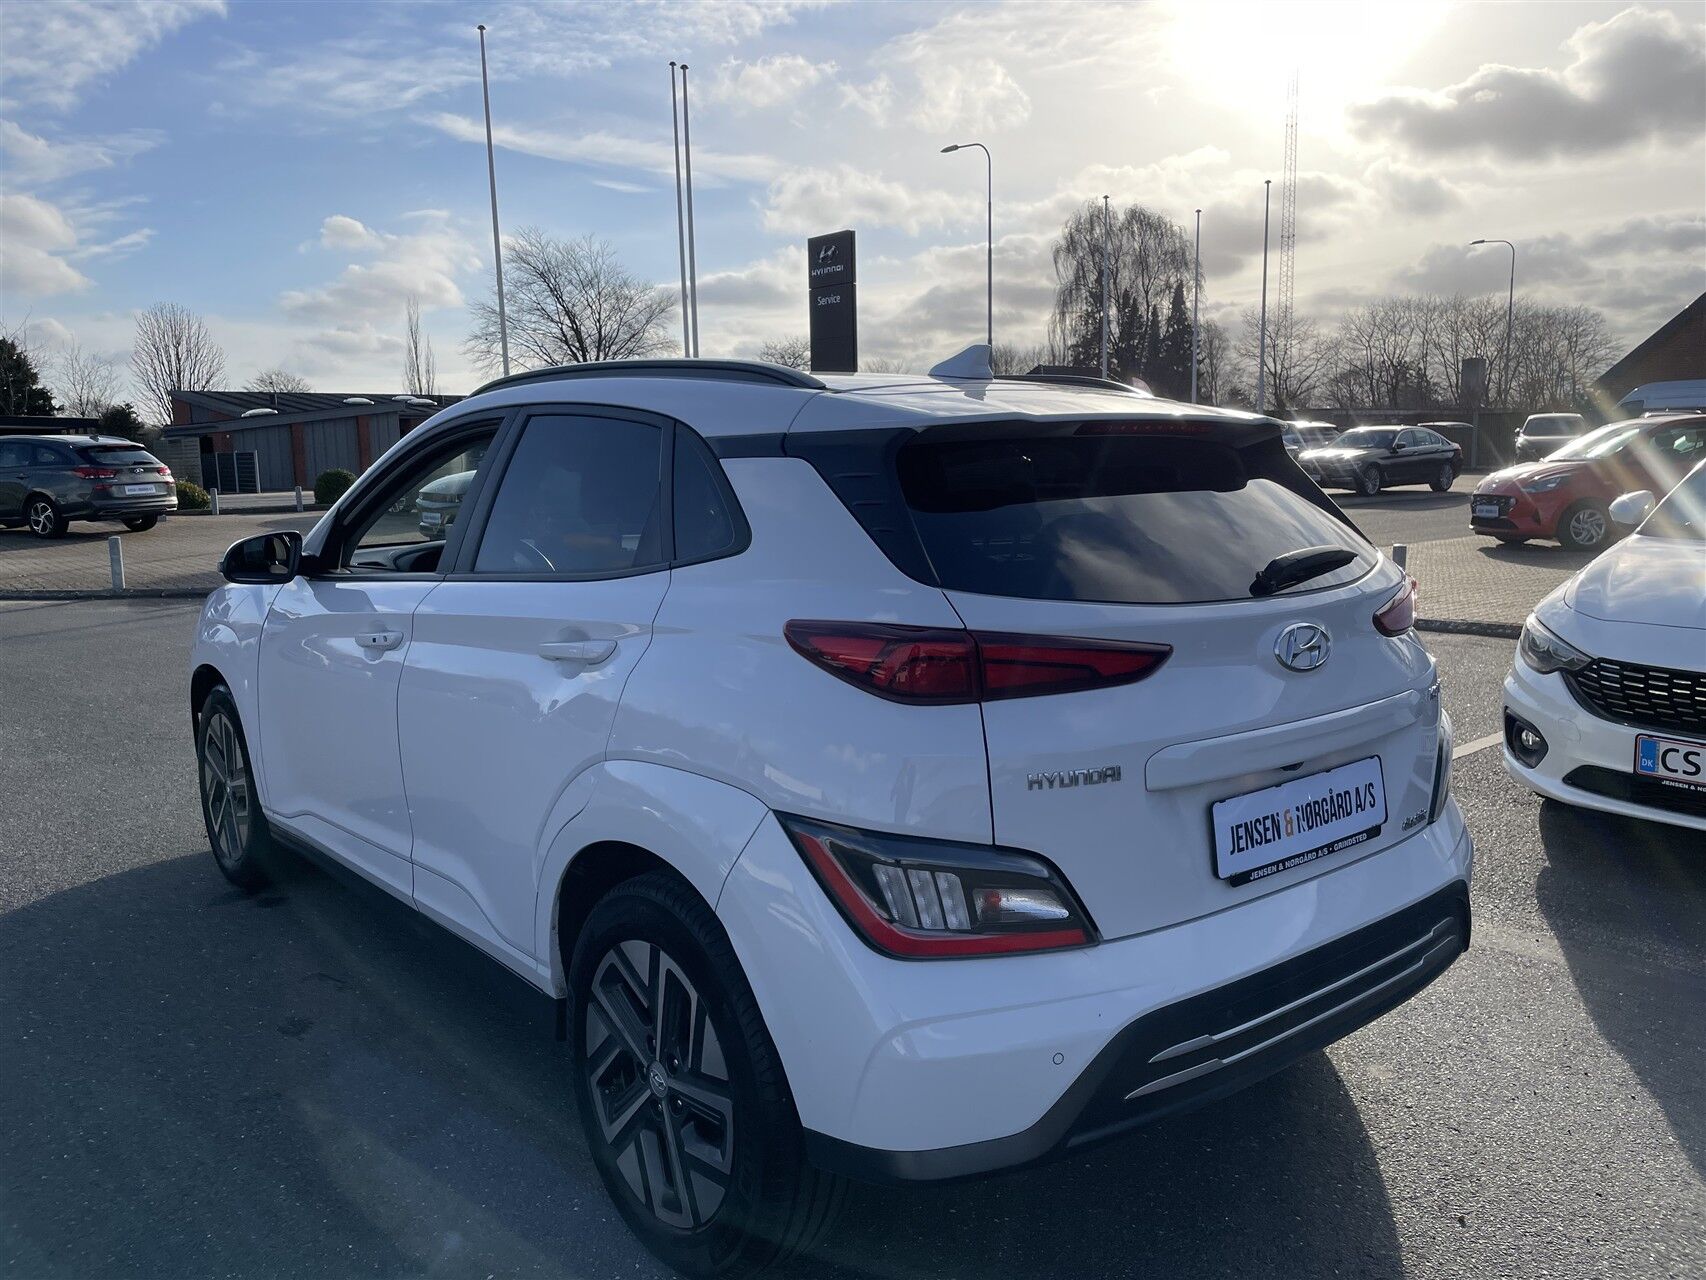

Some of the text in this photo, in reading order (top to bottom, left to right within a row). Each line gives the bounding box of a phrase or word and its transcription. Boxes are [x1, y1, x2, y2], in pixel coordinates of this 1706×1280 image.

[811, 264, 843, 276] HYUNDAI
[817, 293, 841, 306] Service
[1641, 758, 1653, 767] DK
[1661, 748, 1701, 776] CS
[1027, 764, 1121, 791] HYUNDAI
[1661, 780, 1689, 789] JENSEN
[1230, 782, 1376, 856] JENSEN & NØRGÅRD A/S
[1250, 864, 1277, 880] JENSEN
[1278, 863, 1284, 871] &
[1318, 847, 1329, 859] A/S
[1333, 833, 1368, 851] GRINDSTED
